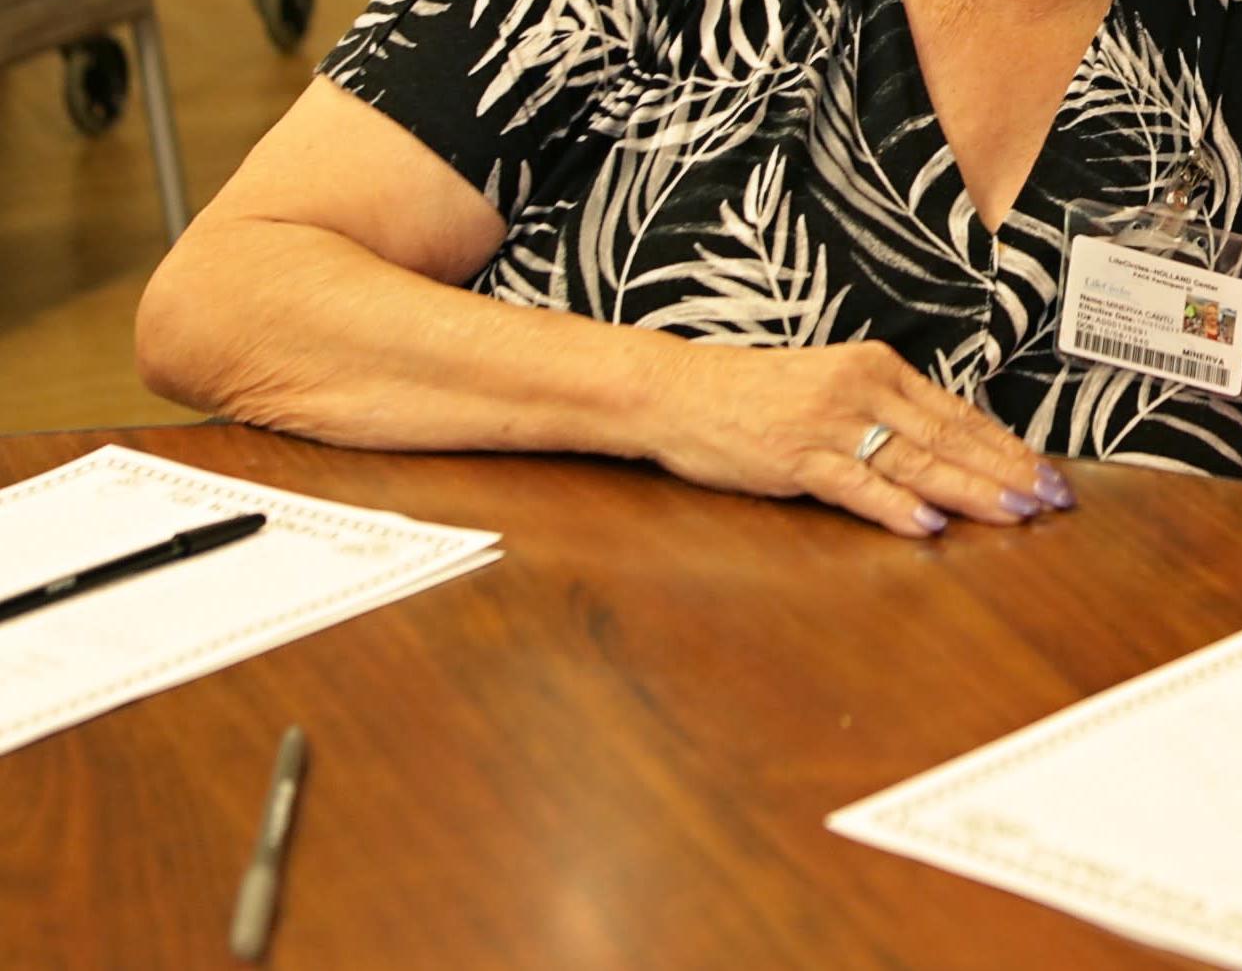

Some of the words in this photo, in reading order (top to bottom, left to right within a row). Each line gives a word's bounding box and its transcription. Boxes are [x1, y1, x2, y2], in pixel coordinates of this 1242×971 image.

[1152, 277, 1185, 291] Participant
[1193, 278, 1218, 291] Center
[1079, 302, 1113, 317] Effective
[1106, 301, 1144, 317] MINERVA
[1182, 348, 1225, 367] MINERVA
